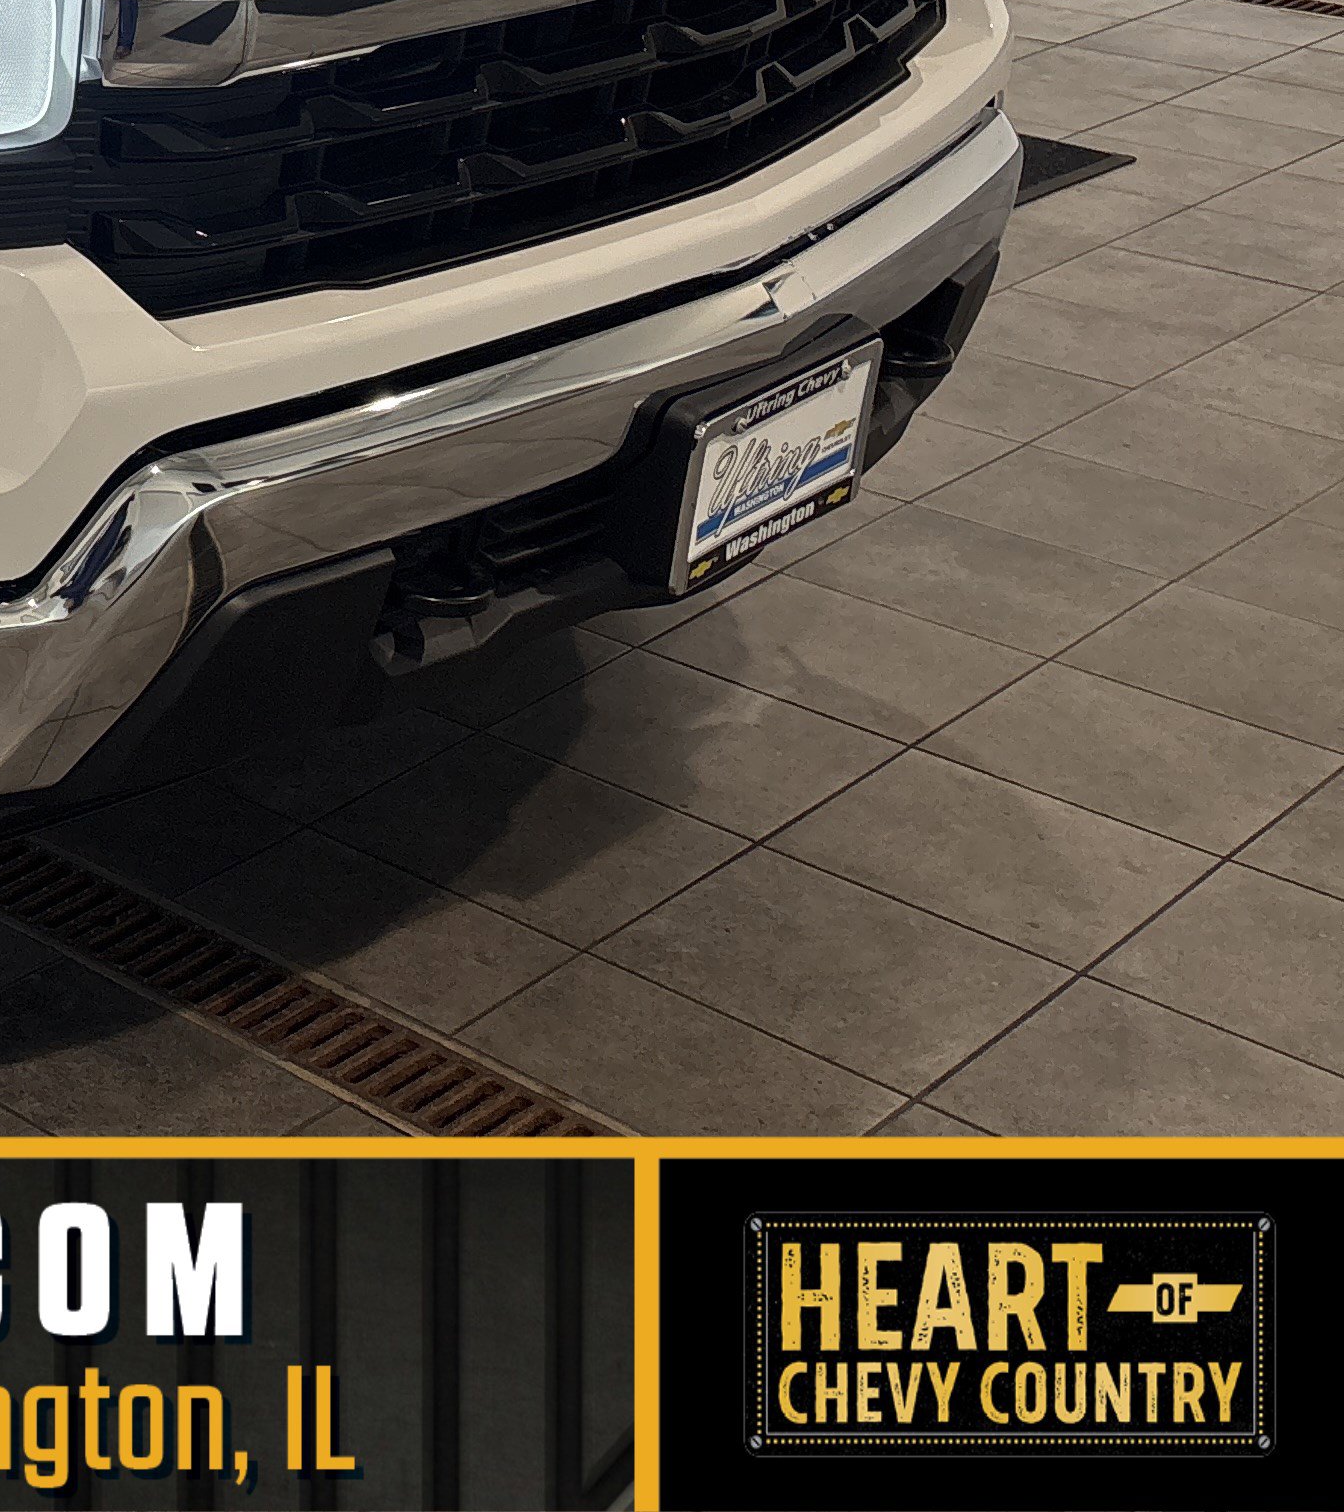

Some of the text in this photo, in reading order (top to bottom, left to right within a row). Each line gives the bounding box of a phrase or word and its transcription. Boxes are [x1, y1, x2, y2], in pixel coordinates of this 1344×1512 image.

[745, 389, 795, 423] Uftring
[710, 437, 821, 538] Uftring
[725, 501, 815, 562] Washington
